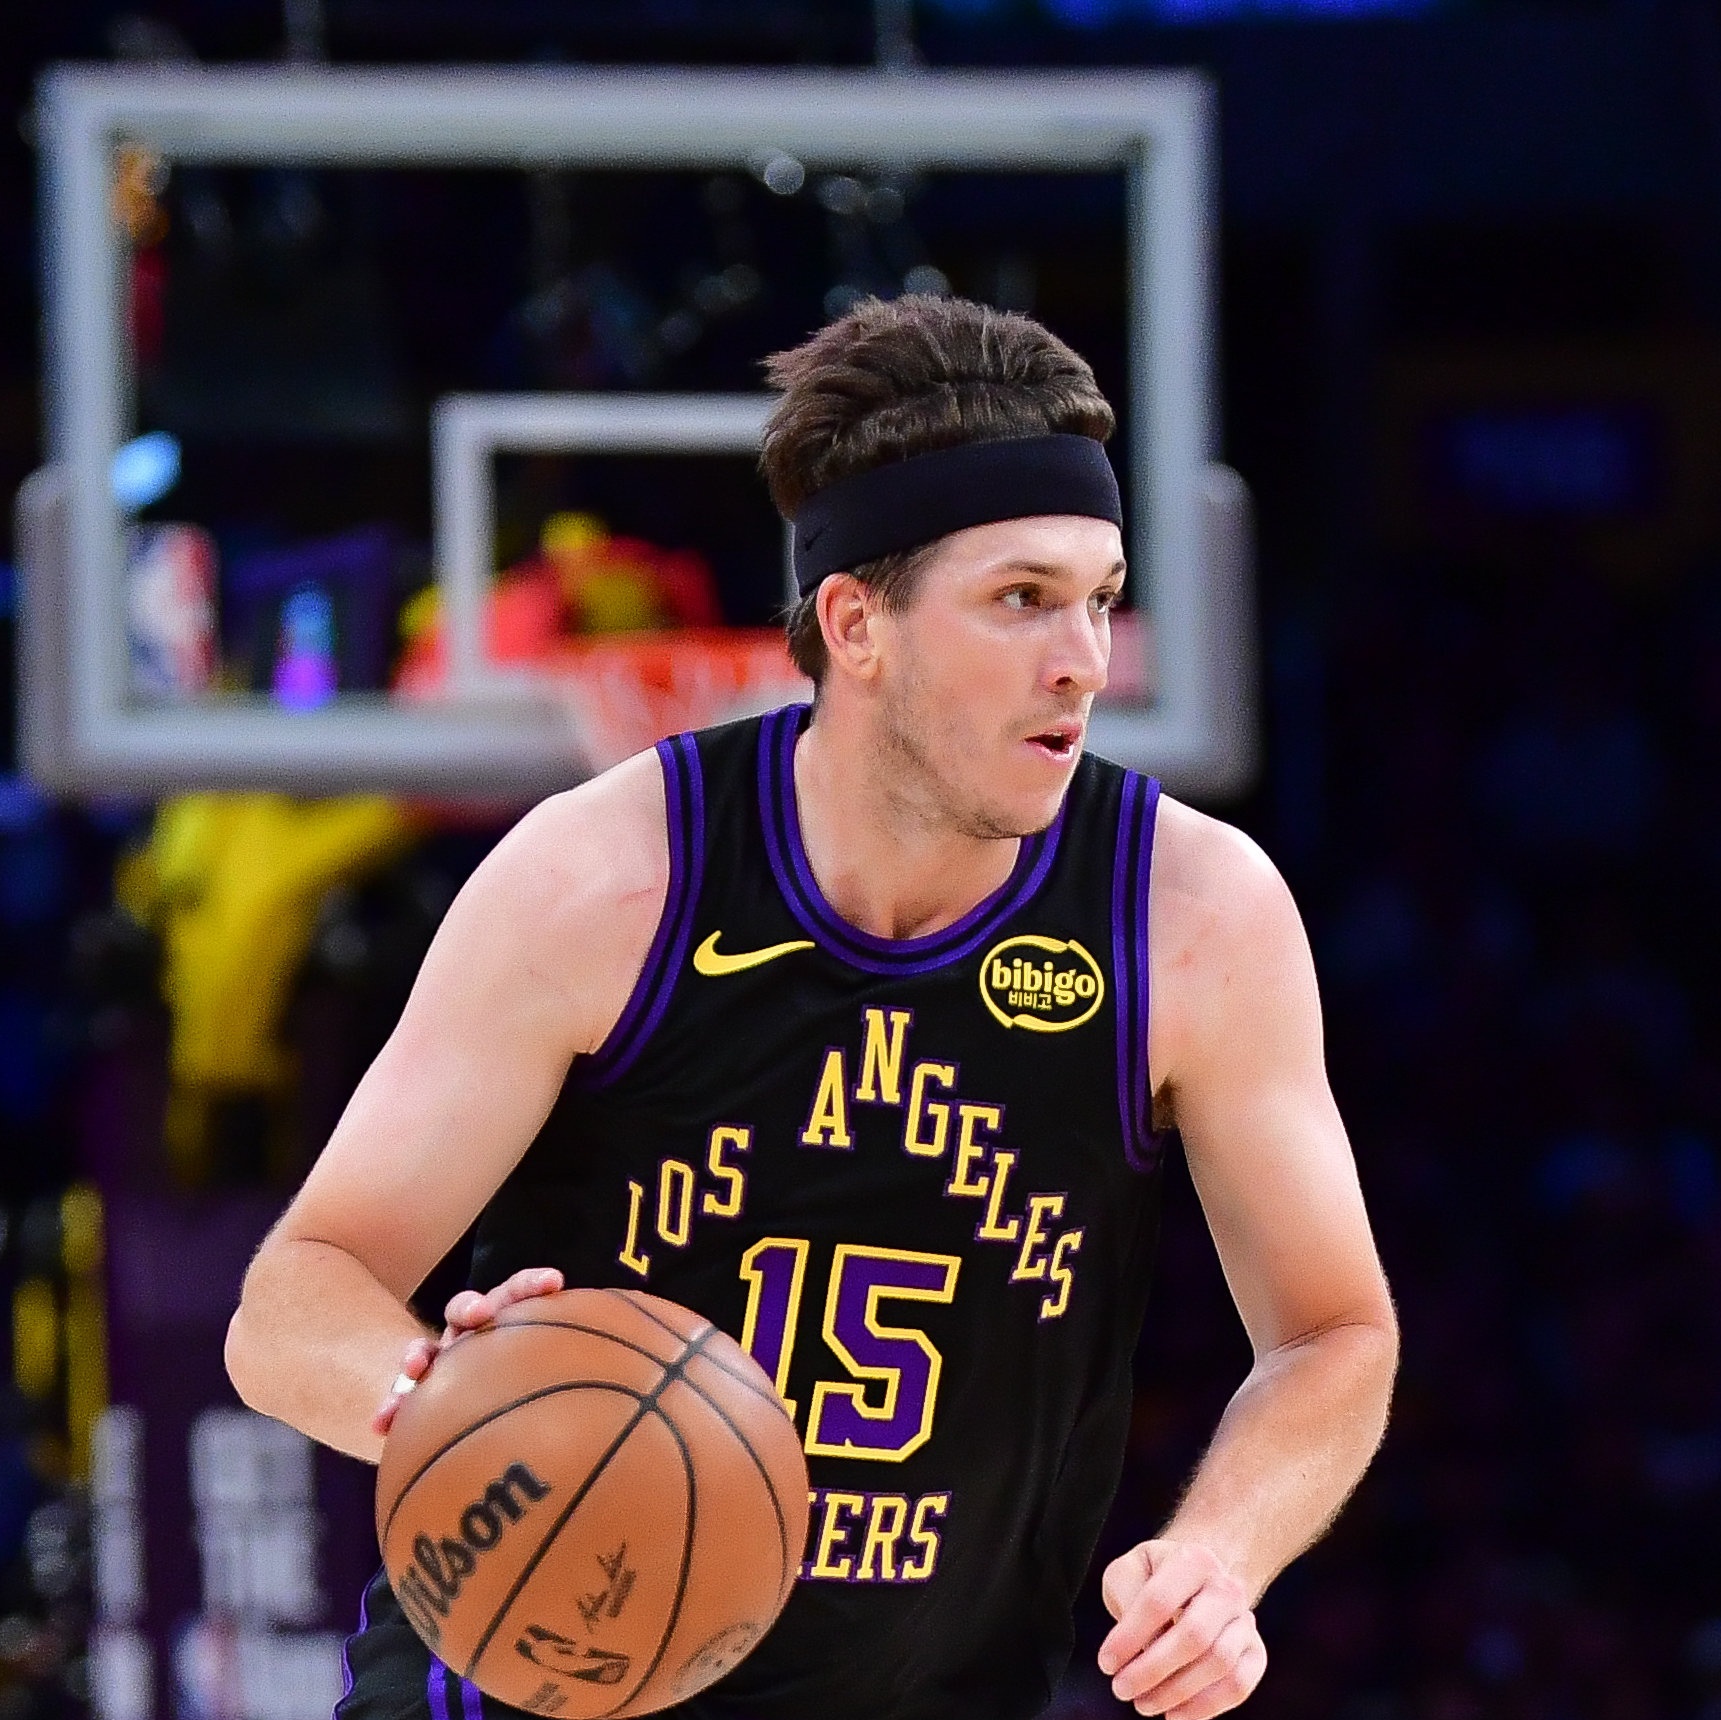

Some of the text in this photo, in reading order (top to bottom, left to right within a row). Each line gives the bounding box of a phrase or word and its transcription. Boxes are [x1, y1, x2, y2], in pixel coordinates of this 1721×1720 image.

[991, 957, 1096, 1006] bibigo
[1008, 990, 1052, 1010] 비비고
[617, 1005, 1084, 1323] LOS ANGELES
[739, 1237, 962, 1462] 15
[797, 1490, 948, 1580] ERS
